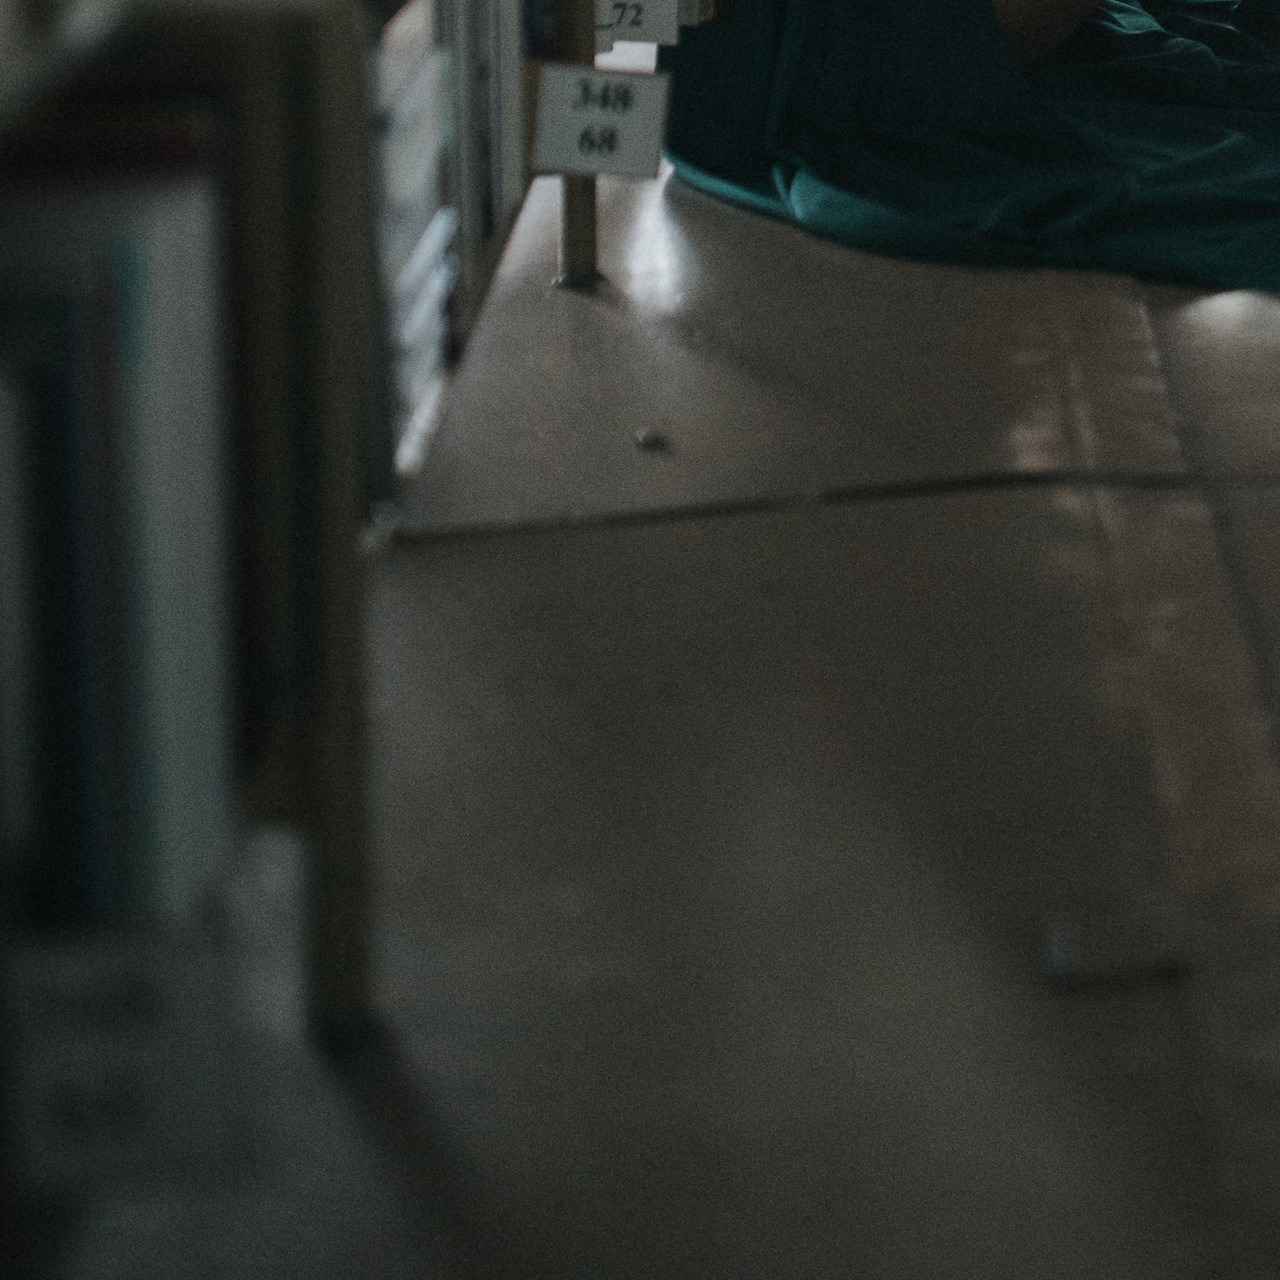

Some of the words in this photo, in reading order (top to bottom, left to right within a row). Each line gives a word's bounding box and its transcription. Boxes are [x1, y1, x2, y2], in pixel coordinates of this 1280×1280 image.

[613, 3, 642, 25] 72
[573, 83, 632, 113] 348
[579, 128, 615, 156] 68
